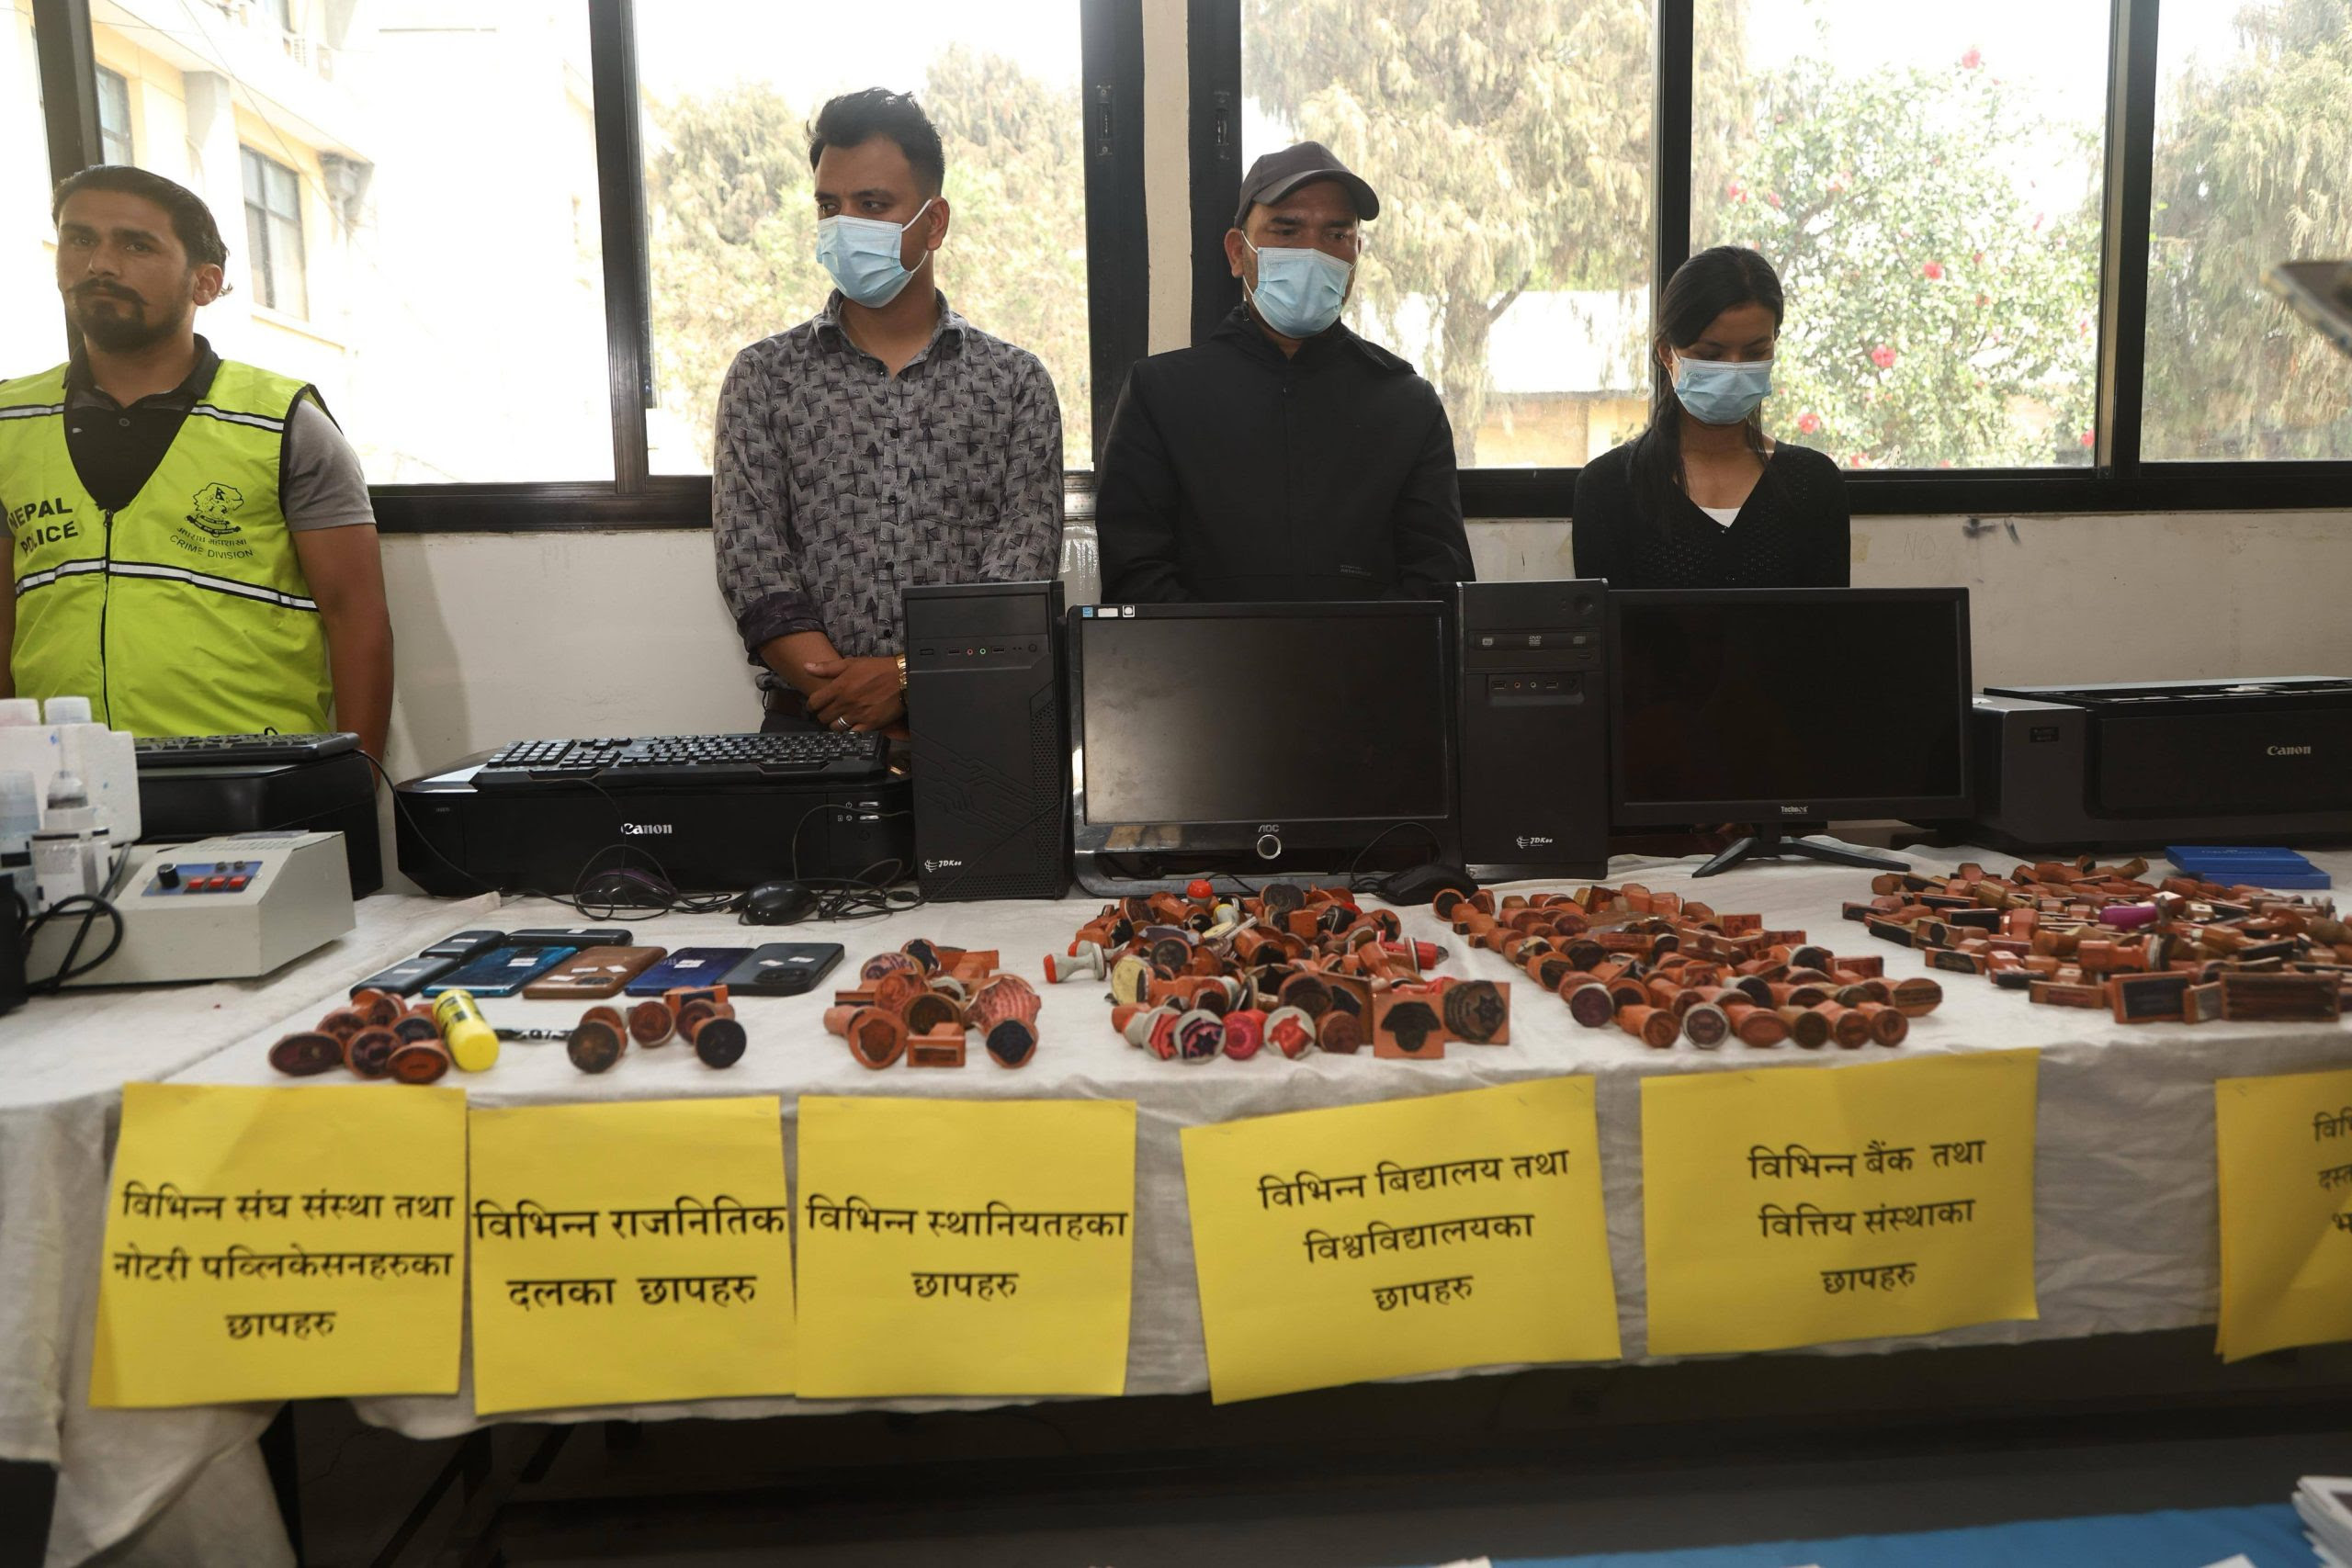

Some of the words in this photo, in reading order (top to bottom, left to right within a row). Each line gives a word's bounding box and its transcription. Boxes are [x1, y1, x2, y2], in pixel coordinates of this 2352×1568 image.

[8, 498, 74, 529] NEPAL
[170, 535, 203, 555] CRIME
[208, 549, 254, 559] DIVISION
[2267, 746, 2312, 756] Canon
[621, 823, 673, 835] Canon
[1748, 1144, 1856, 1179] विभिन्न
[1863, 1139, 1915, 1174] बैंक
[1929, 1139, 1986, 1168] तथा
[1257, 1170, 1367, 1210] विभिन्न
[1374, 1156, 1503, 1195] बिद्यालय
[1510, 1148, 1570, 1179] तथा
[122, 1180, 226, 1221] विभिन्न
[235, 1190, 292, 1221] संघ
[301, 1189, 384, 1221] संस्था
[392, 1195, 454, 1220] तथा
[471, 1199, 599, 1239] विभिन्न
[608, 1195, 787, 1239] राजनितिक
[805, 1193, 918, 1235] विभिन्न
[926, 1201, 1129, 1240] स्थानियतहका
[1758, 1202, 1856, 1238] वित्तिय
[1863, 1199, 1976, 1234] संस्थाका
[1304, 1213, 1535, 1263] विश्वविद्यालयका
[114, 1242, 192, 1281] नोटरी
[1821, 1262, 1917, 1294] छापहरु
[506, 1278, 617, 1312] दलका
[636, 1275, 757, 1307] छापहरु
[910, 1271, 1020, 1302] छापहरु
[1372, 1275, 1474, 1312] छापहरु
[225, 1311, 337, 1340] छापहरु
